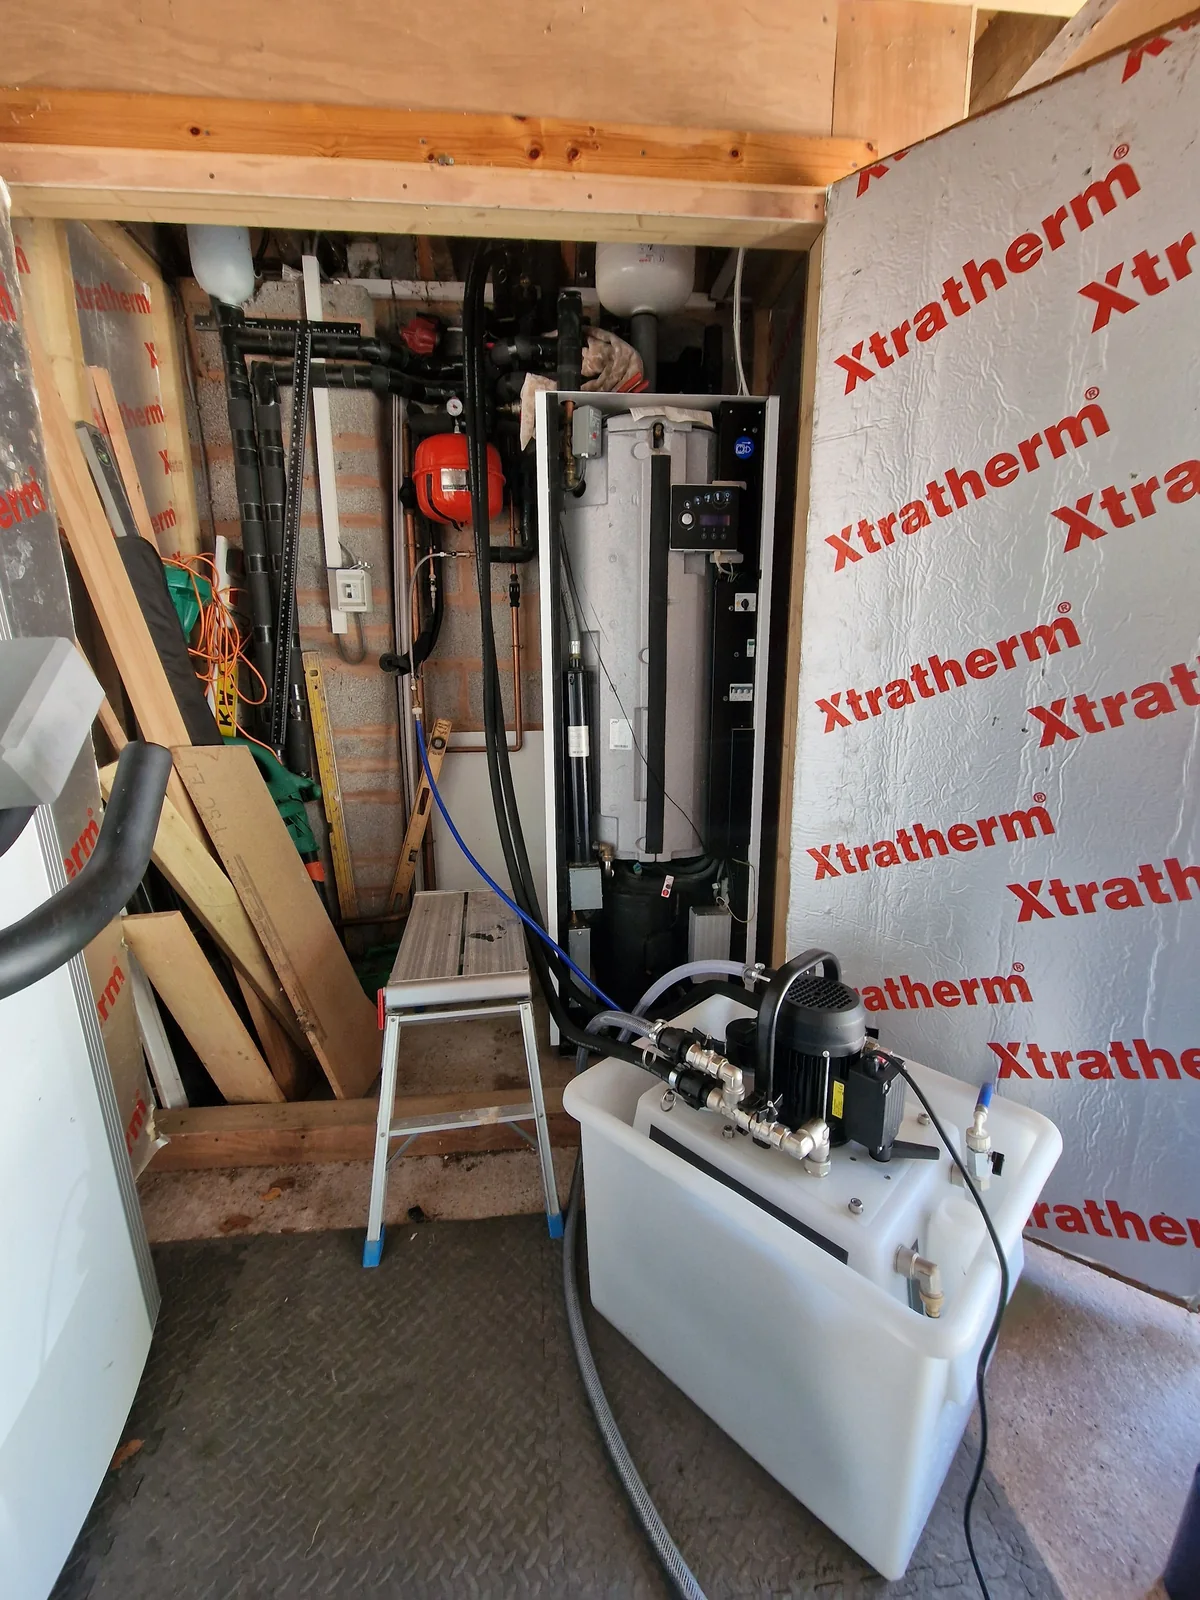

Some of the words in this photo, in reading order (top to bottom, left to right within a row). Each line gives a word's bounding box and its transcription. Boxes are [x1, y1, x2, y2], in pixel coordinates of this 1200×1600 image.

[1077, 231, 1197, 334] Xtr
[1050, 459, 1200, 553] Xtra
[1027, 655, 1200, 749] Xtrat
[1006, 857, 1200, 923] Xtrath
